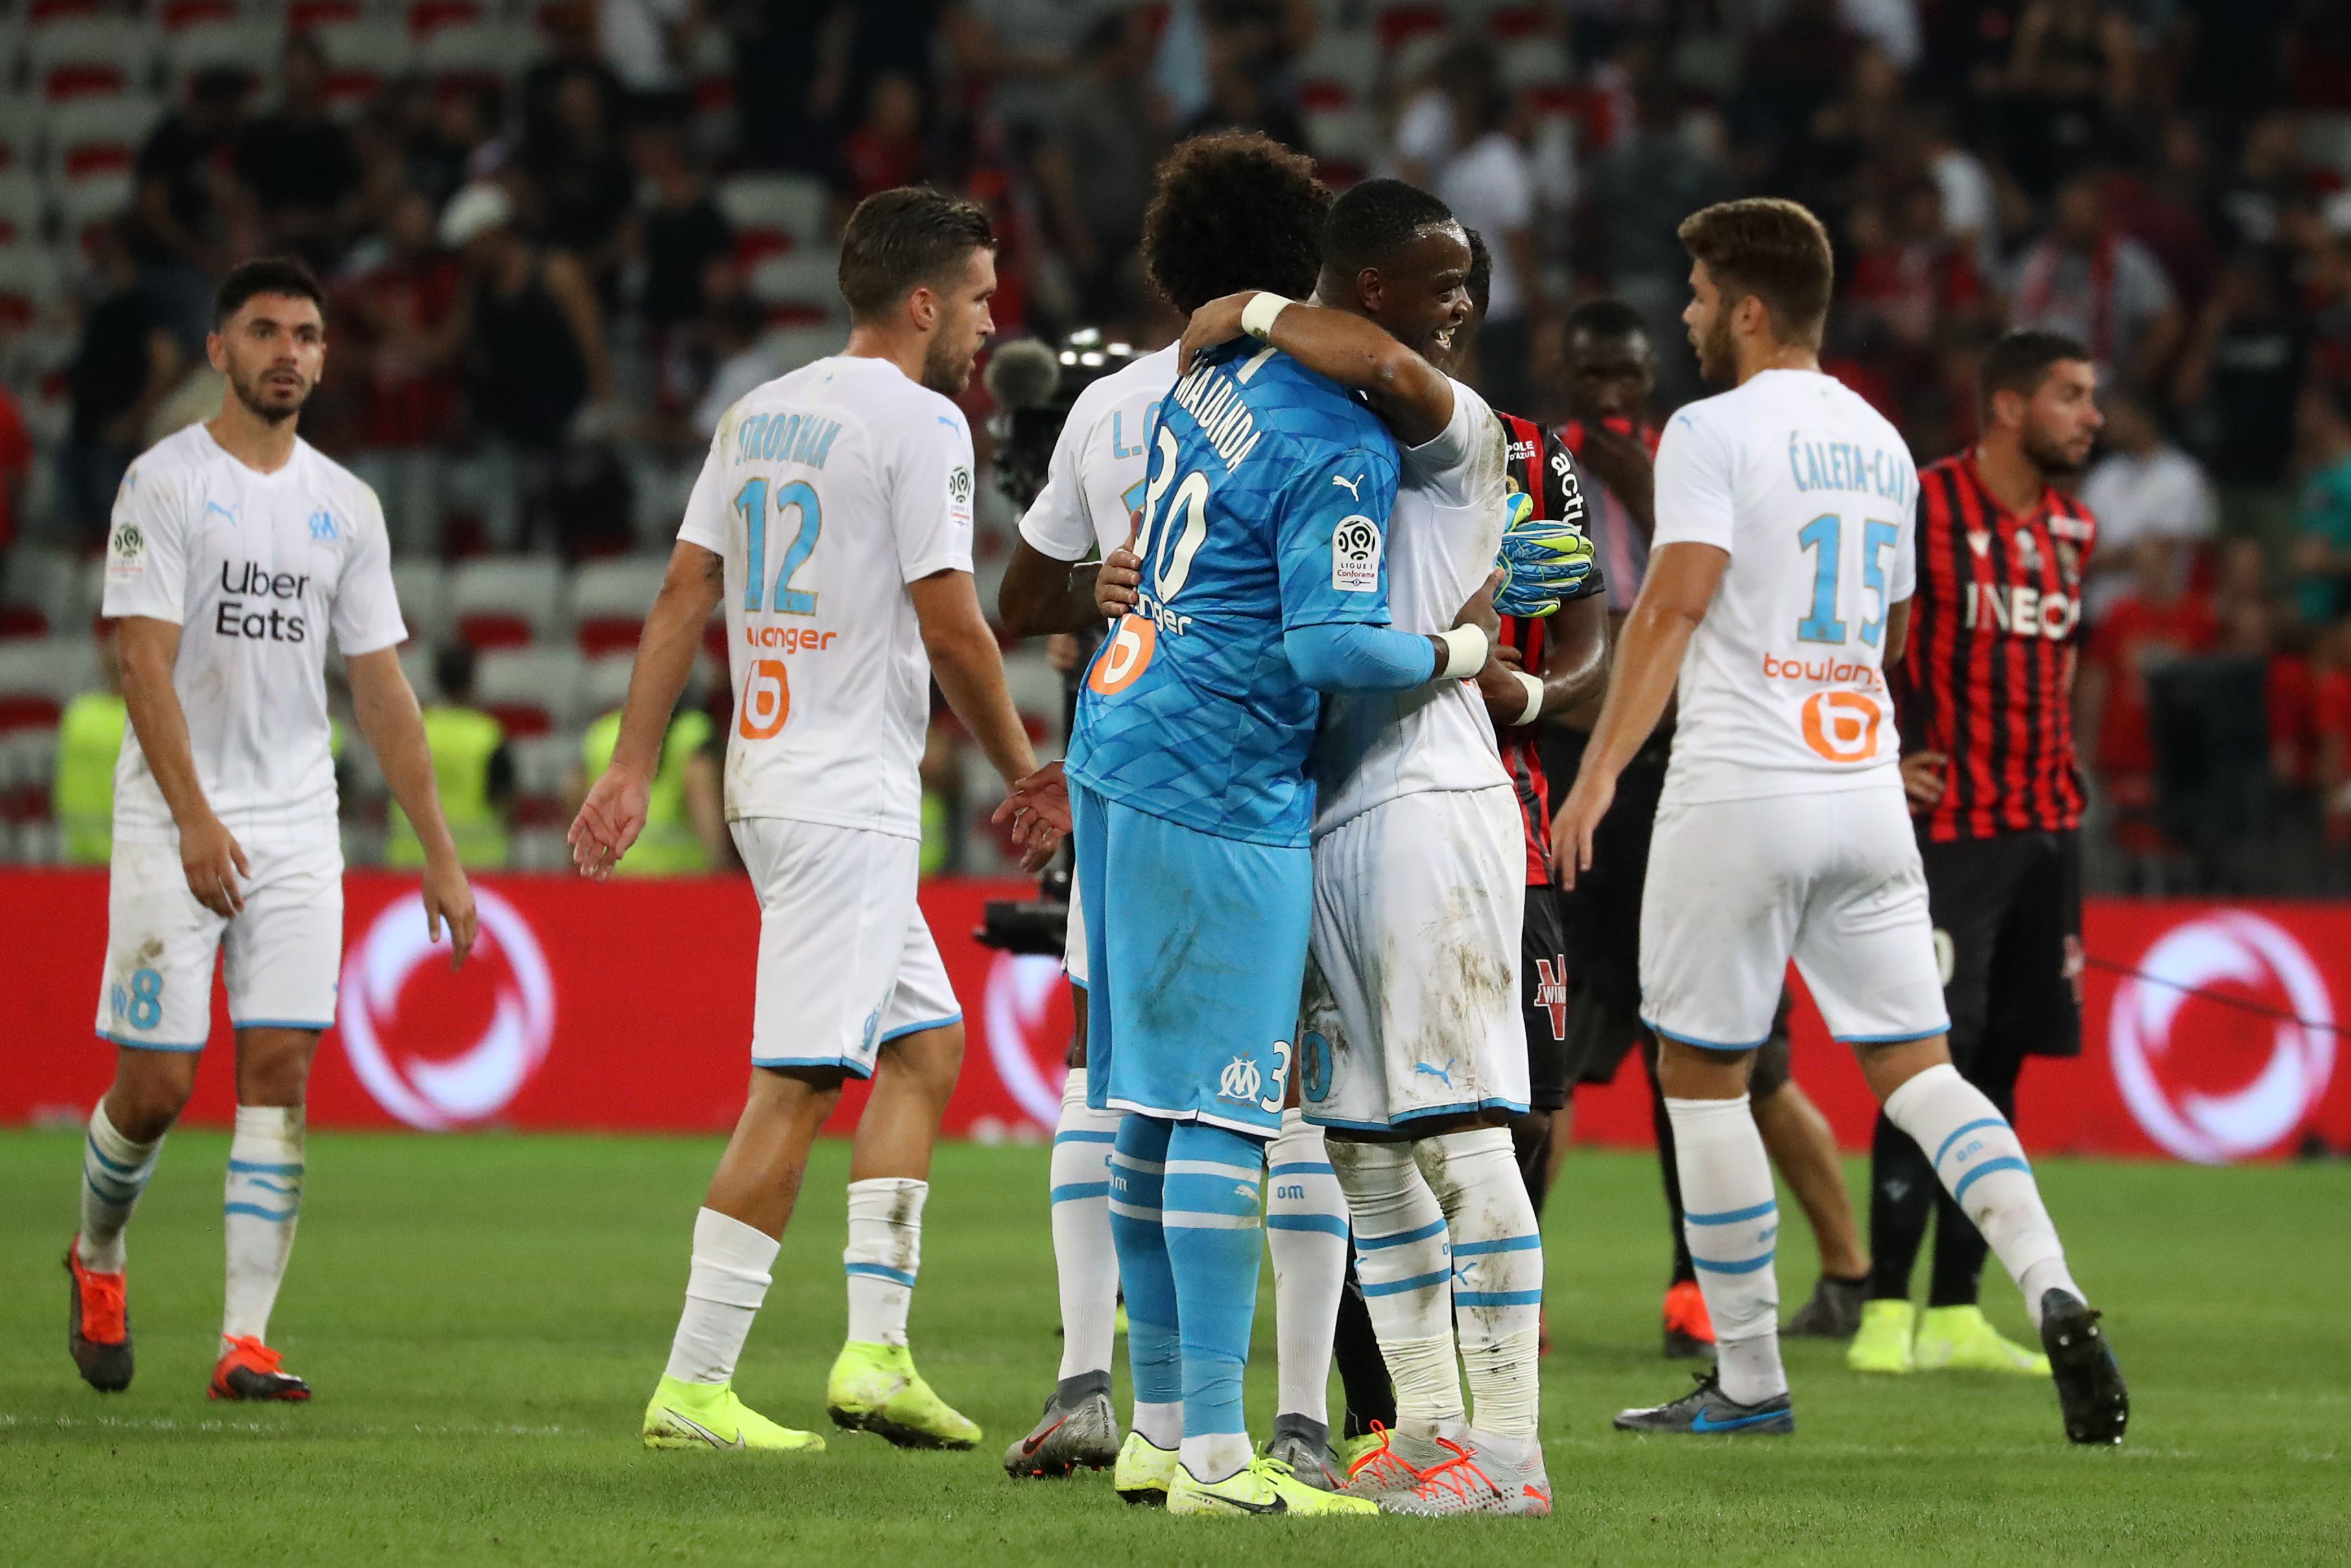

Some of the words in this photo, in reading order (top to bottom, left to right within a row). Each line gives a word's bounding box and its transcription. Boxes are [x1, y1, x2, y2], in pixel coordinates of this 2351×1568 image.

[1509, 450, 1536, 461] D'AZUR
[1132, 425, 1210, 605] 30
[733, 477, 822, 617] 12
[221, 560, 310, 600] Uber
[1337, 569, 1375, 578] Conforama
[1796, 513, 1900, 648] 15
[215, 601, 305, 643] Eats
[128, 967, 163, 1031] 8
[1277, 1185, 1305, 1200] om
